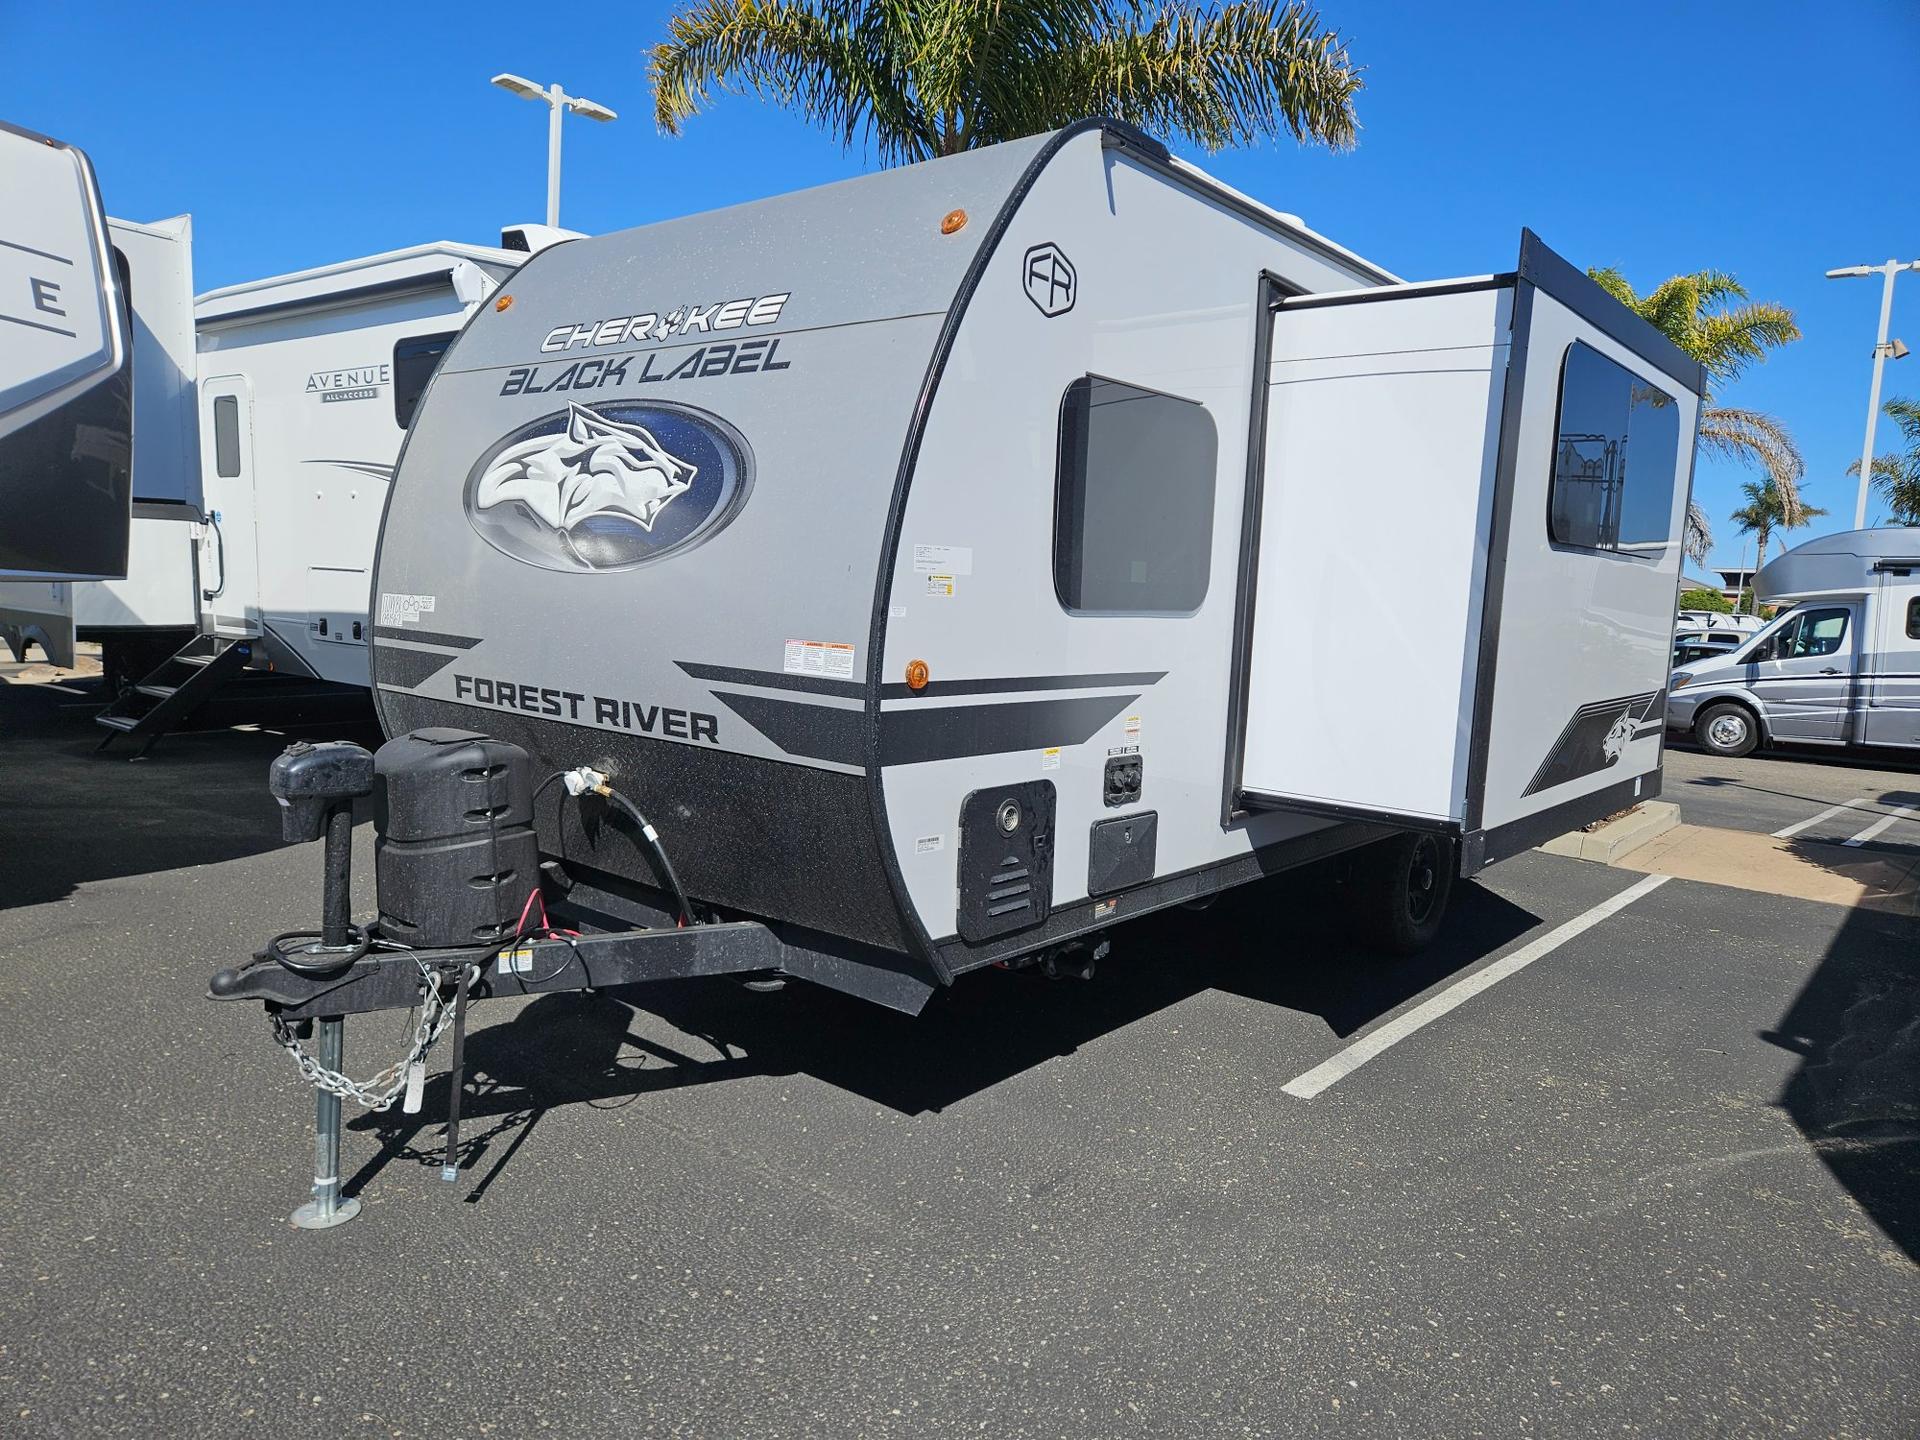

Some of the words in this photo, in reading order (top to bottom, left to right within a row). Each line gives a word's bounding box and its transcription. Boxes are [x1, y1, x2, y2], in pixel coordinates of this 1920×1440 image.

[306, 364, 390, 390] AVENUE
[499, 356, 634, 397] BLACK
[638, 339, 791, 383] LABEL
[325, 390, 375, 401] ALL-ACCESS
[453, 674, 585, 719] FOREST
[593, 696, 720, 744] RIVER
